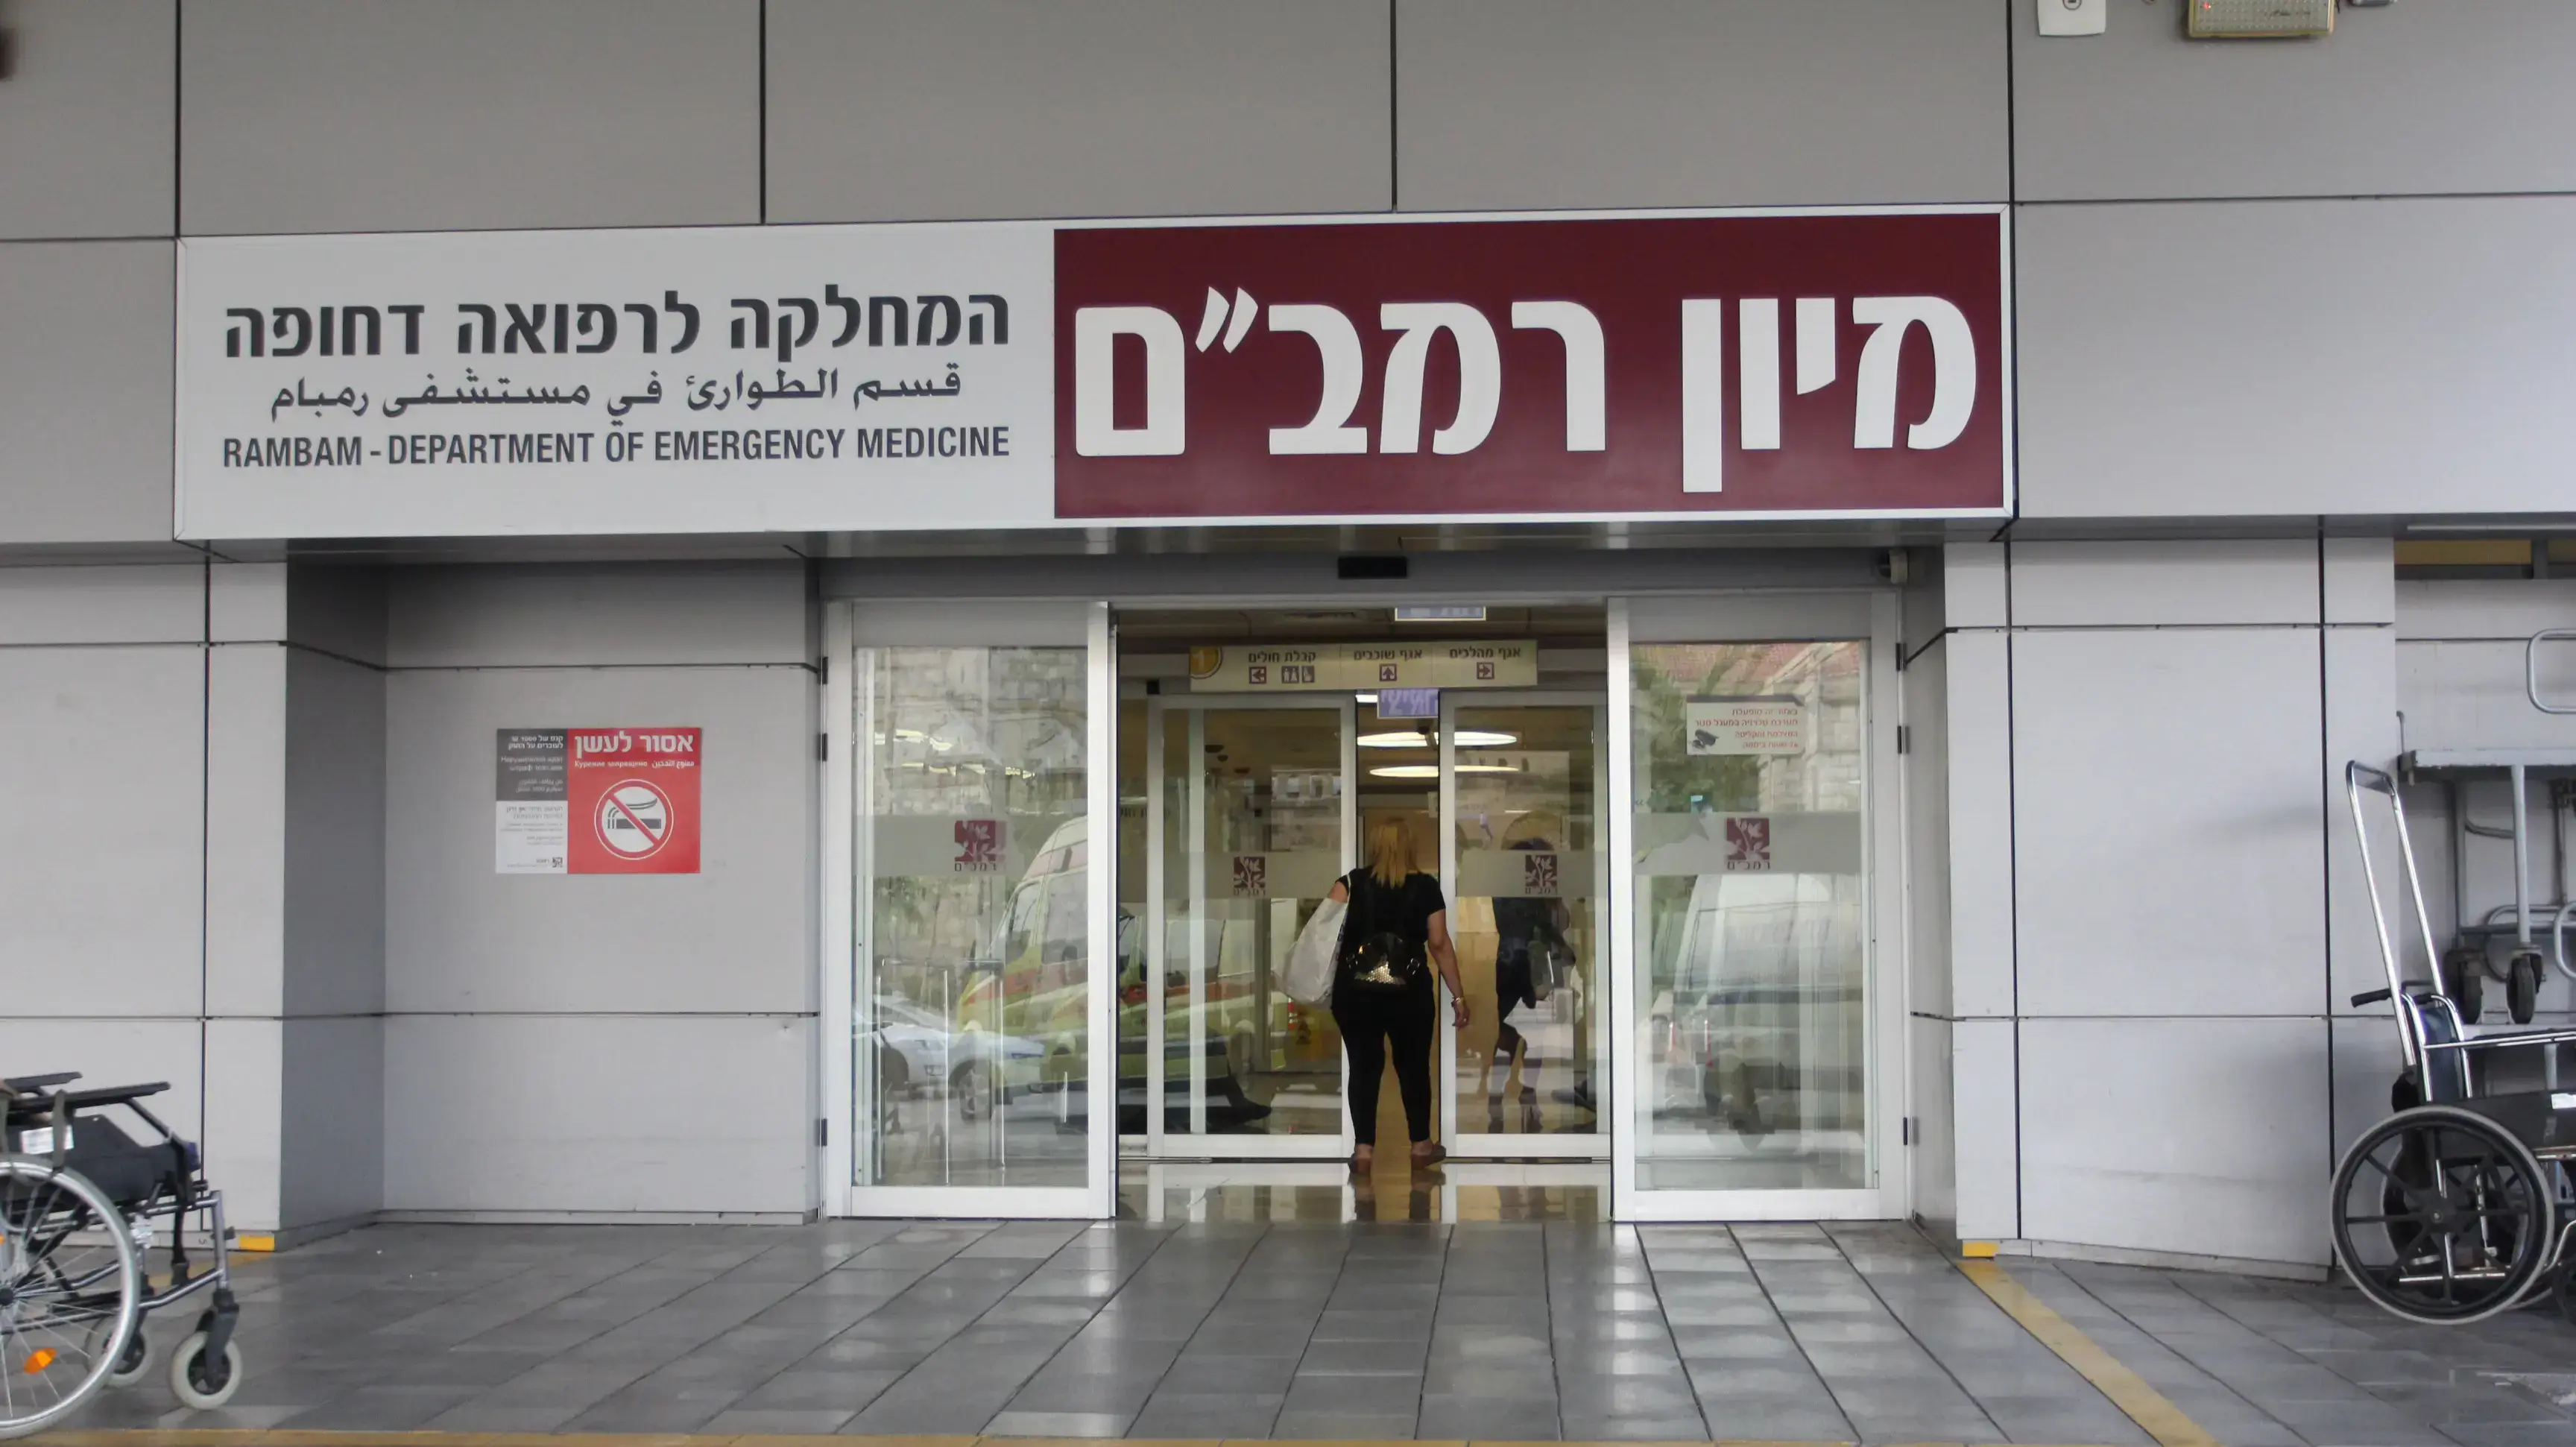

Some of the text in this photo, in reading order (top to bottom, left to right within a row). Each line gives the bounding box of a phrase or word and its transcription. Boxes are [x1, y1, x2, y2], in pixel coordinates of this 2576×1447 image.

[227, 285, 1008, 362] המחלקה לרפואה דחופה
[272, 363, 961, 426] قسم الطوارئ في مستشفى رمبام
[1682, 297, 1977, 493] מיון
[224, 437, 362, 467] RAMBAM
[390, 433, 595, 464] DEPARTMENT
[606, 432, 644, 461] OF
[656, 429, 845, 461] EMERGENCY
[858, 427, 1009, 458] MEDICINE
[1248, 650, 1316, 663] קבלת חולים
[1354, 649, 1423, 661] אגף שוכבים
[1449, 646, 1521, 660] אגף מהלכים
[575, 731, 694, 759] אסור לעשן
[575, 760, 605, 769] Курение
